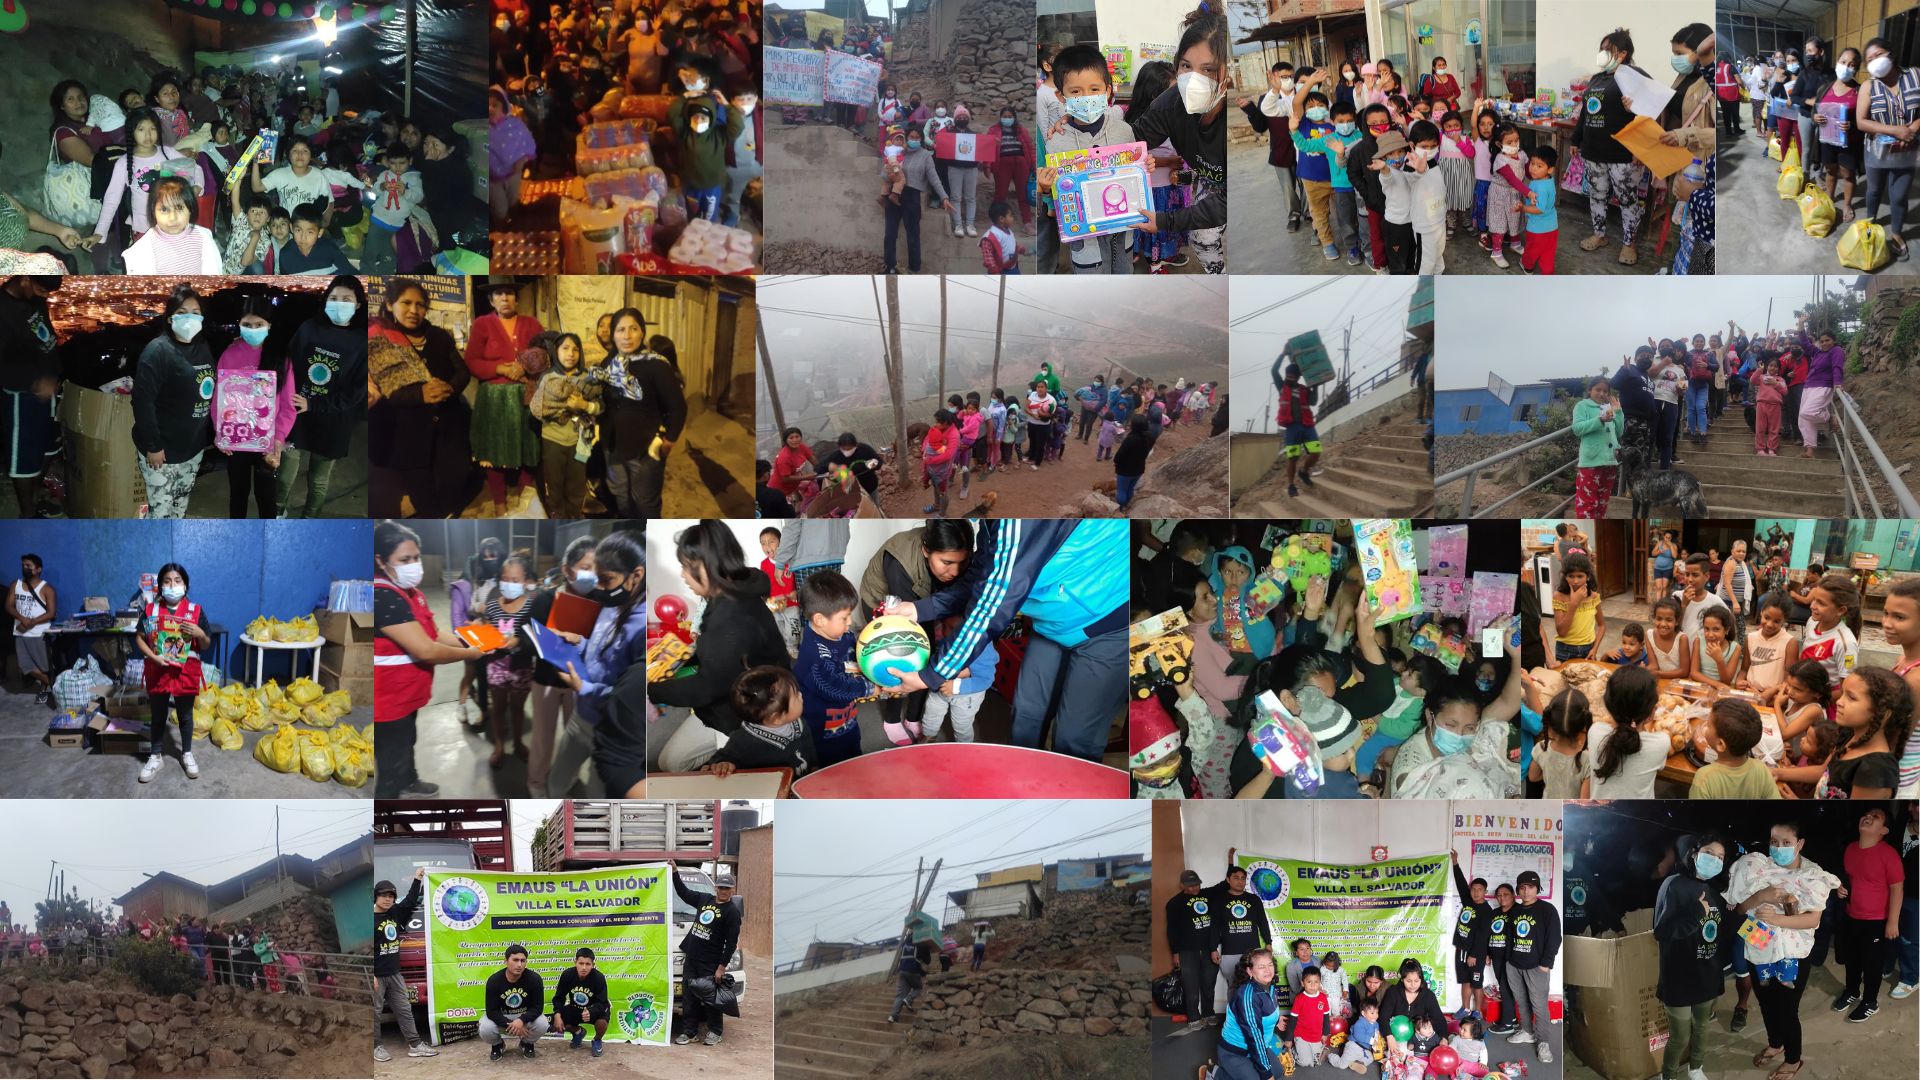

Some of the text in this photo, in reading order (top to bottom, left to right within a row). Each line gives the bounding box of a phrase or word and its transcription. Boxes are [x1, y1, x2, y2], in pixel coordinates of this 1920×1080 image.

[424, 275, 458, 286] UNIDAS
[421, 283, 462, 295] OCTUBRE
[1752, 646, 1777, 659] NIKE
[1475, 844, 1501, 854] PANEL
[1297, 866, 1351, 880] EMAUS
[496, 881, 556, 894] EMAUS
[1313, 881, 1426, 893] VILLA EL SALVADOR
[516, 897, 641, 910] VILLA EL SALVADOR
[500, 987, 528, 1000] EMAÚS
[447, 1008, 476, 1018] DONA
